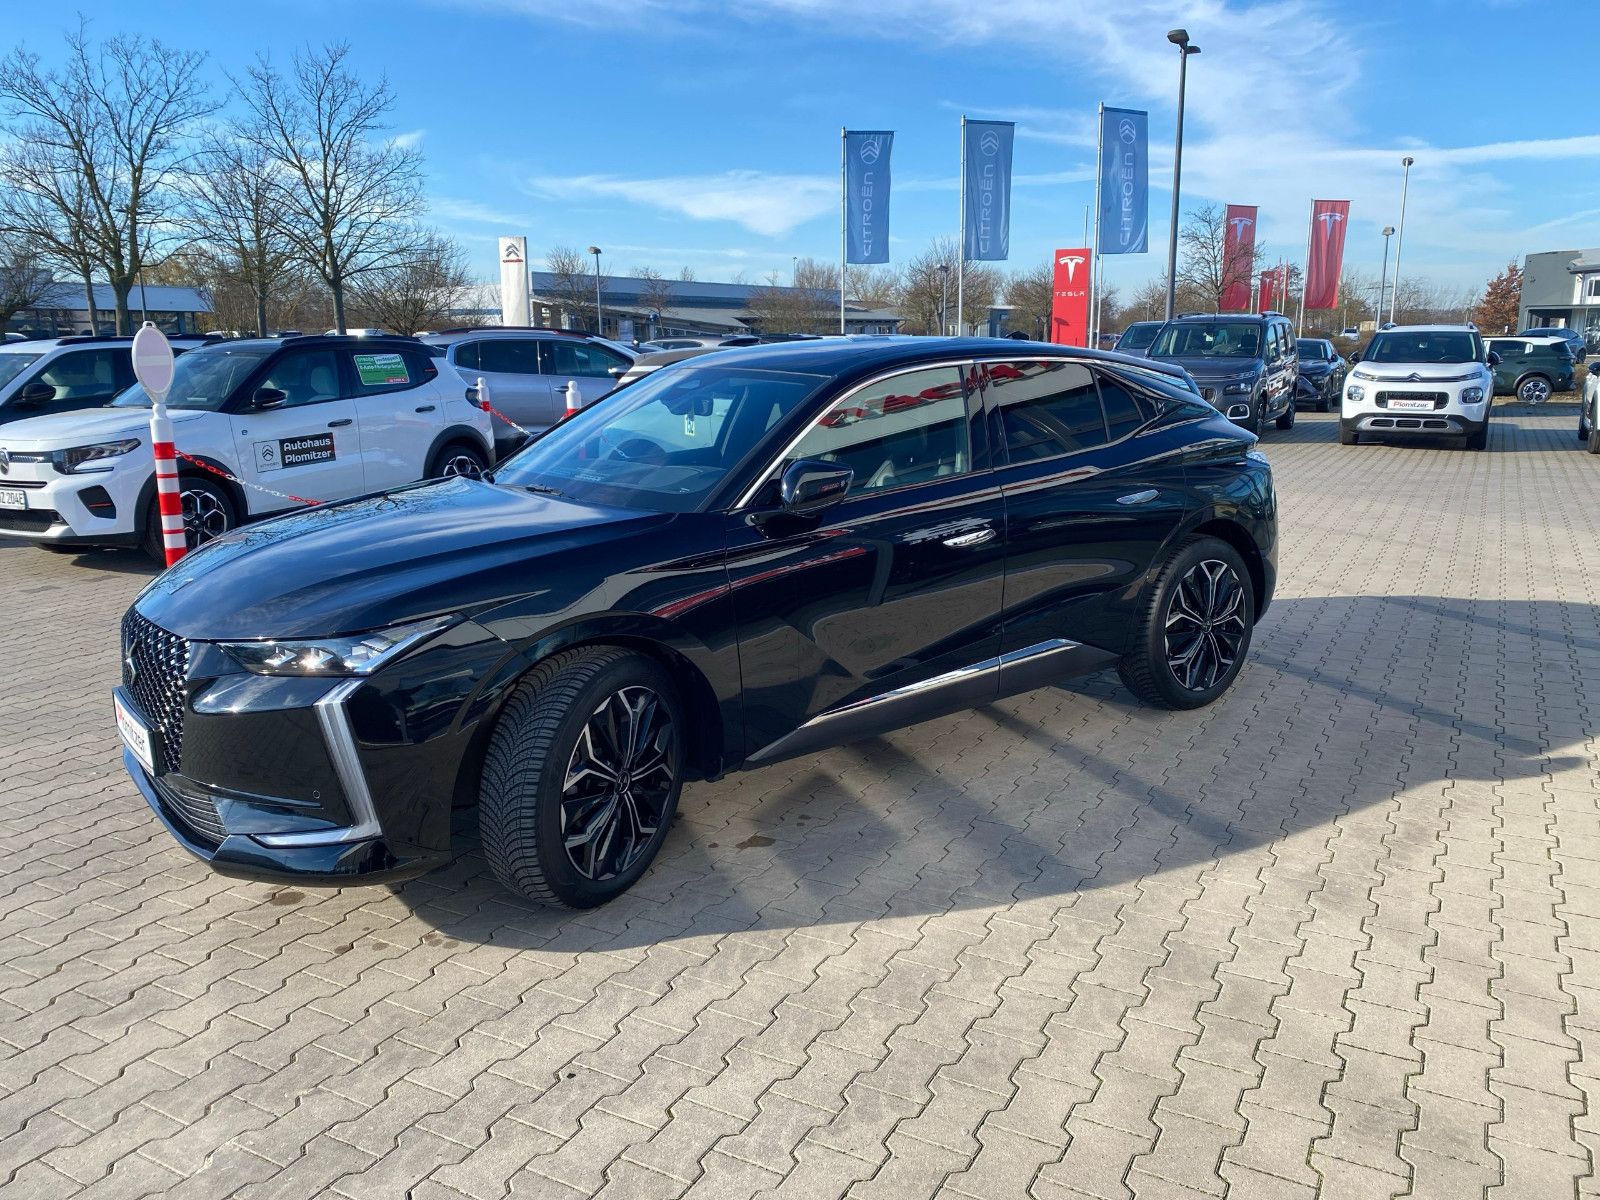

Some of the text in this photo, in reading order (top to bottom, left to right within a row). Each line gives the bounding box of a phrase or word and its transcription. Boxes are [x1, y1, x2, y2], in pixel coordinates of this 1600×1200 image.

[862, 171, 873, 257] CITROËN
[1120, 152, 1134, 246] CITROËN
[283, 438, 331, 452] Autohaus
[284, 450, 332, 464] Plomitzer
